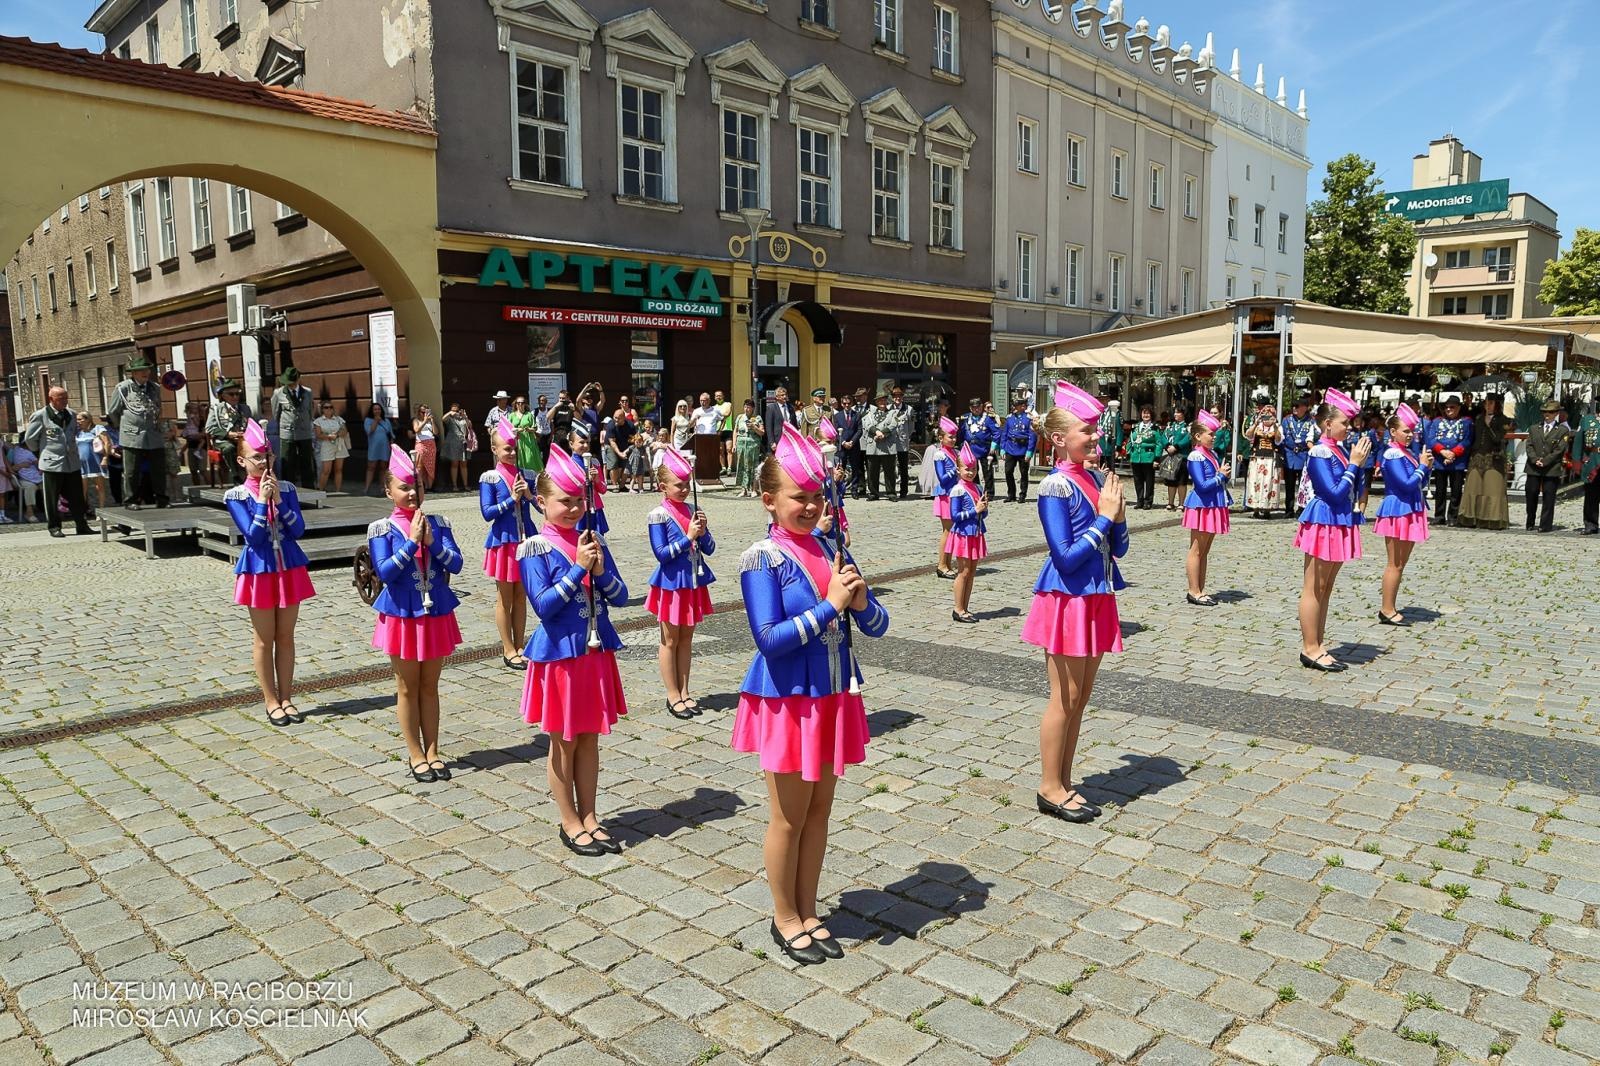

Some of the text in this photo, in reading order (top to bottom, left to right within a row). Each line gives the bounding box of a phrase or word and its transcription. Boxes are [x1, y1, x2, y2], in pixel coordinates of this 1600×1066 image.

[1407, 195, 1473, 210] McDonald's
[478, 247, 722, 301] APTEKA
[648, 301, 719, 315] POD RÓŻAMI
[510, 309, 548, 320] RYNEK
[550, 311, 563, 320] 12
[571, 312, 619, 324] CENTRUM
[621, 315, 703, 328] FARMACEUTYCZNE
